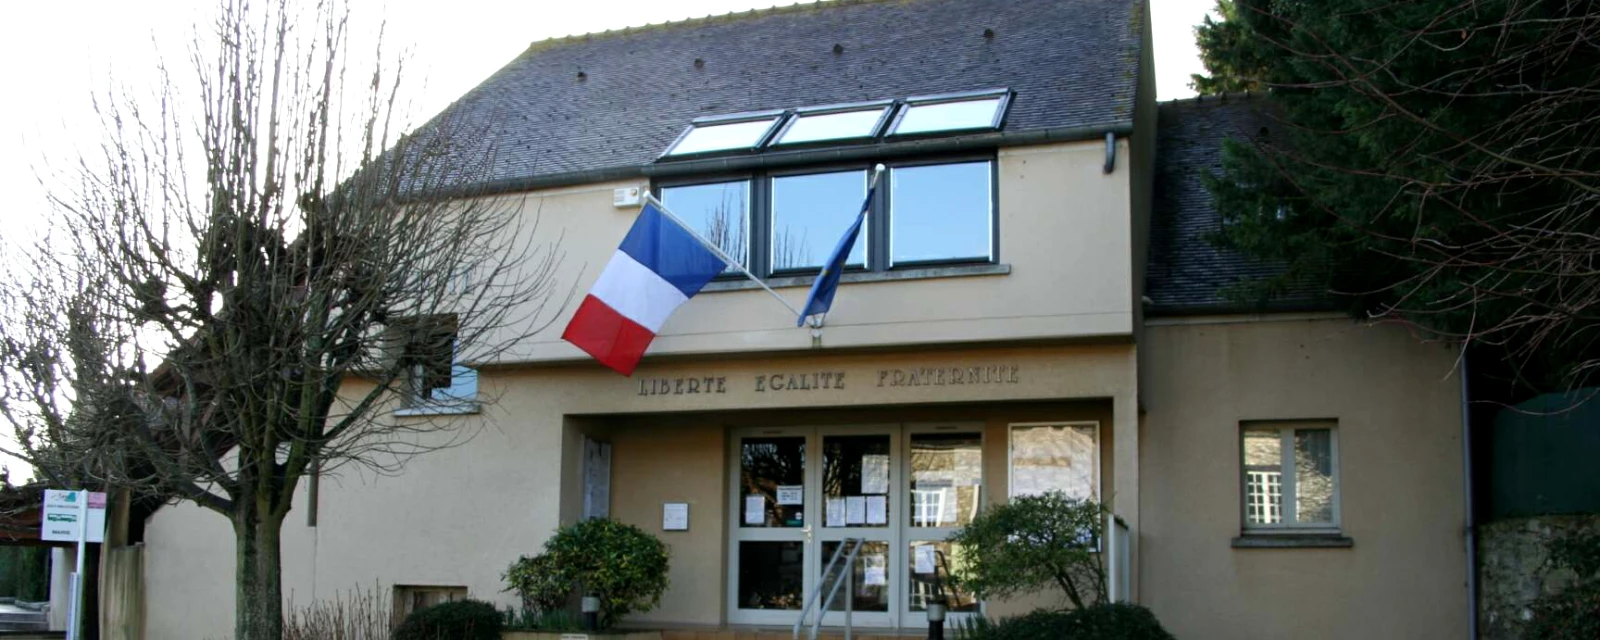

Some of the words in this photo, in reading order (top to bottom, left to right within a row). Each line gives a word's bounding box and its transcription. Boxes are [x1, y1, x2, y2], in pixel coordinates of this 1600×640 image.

[637, 375, 727, 396] LIBERTE
[754, 371, 846, 392] EGALITE
[876, 363, 1020, 387] FRATERNITE
